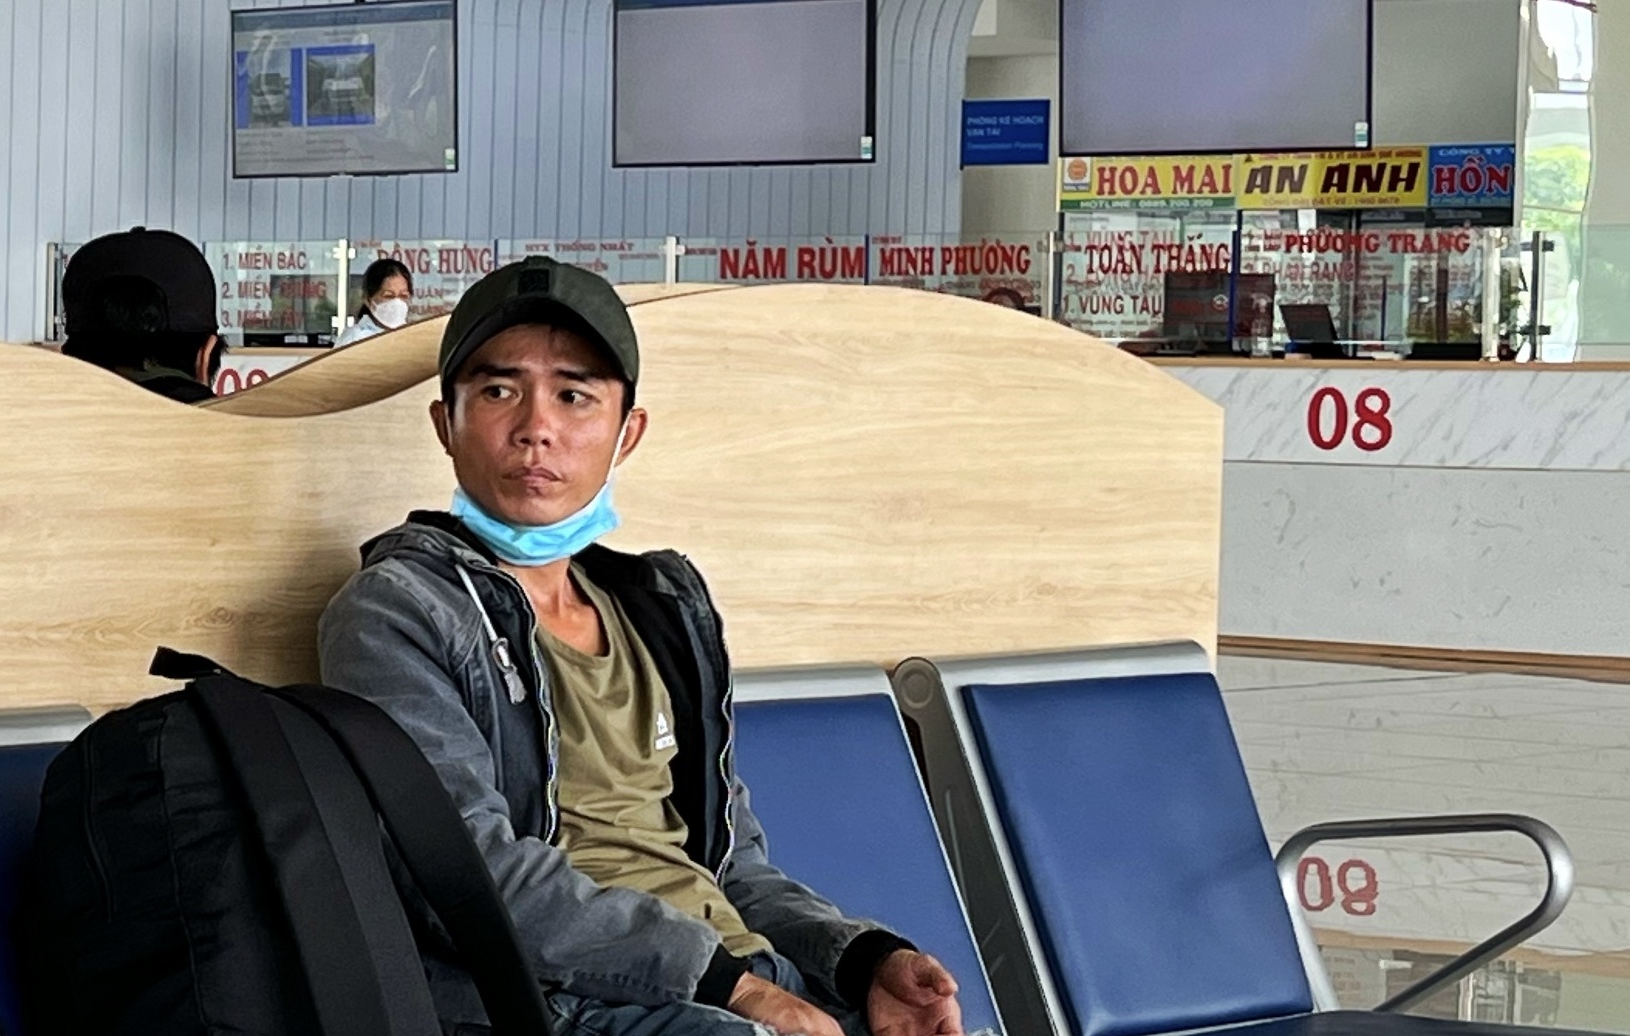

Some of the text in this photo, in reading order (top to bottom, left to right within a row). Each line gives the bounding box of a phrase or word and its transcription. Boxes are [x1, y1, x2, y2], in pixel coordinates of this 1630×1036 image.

[1096, 164, 1232, 195] HOA MAI
[1244, 162, 1420, 194] AN ANH
[721, 236, 864, 279] NĂM RÙM
[879, 237, 1031, 276] MINH PHƯƠNG
[1387, 229, 1471, 254] TRANG
[437, 243, 494, 274] HƯNG
[1308, 387, 1392, 451] 08
